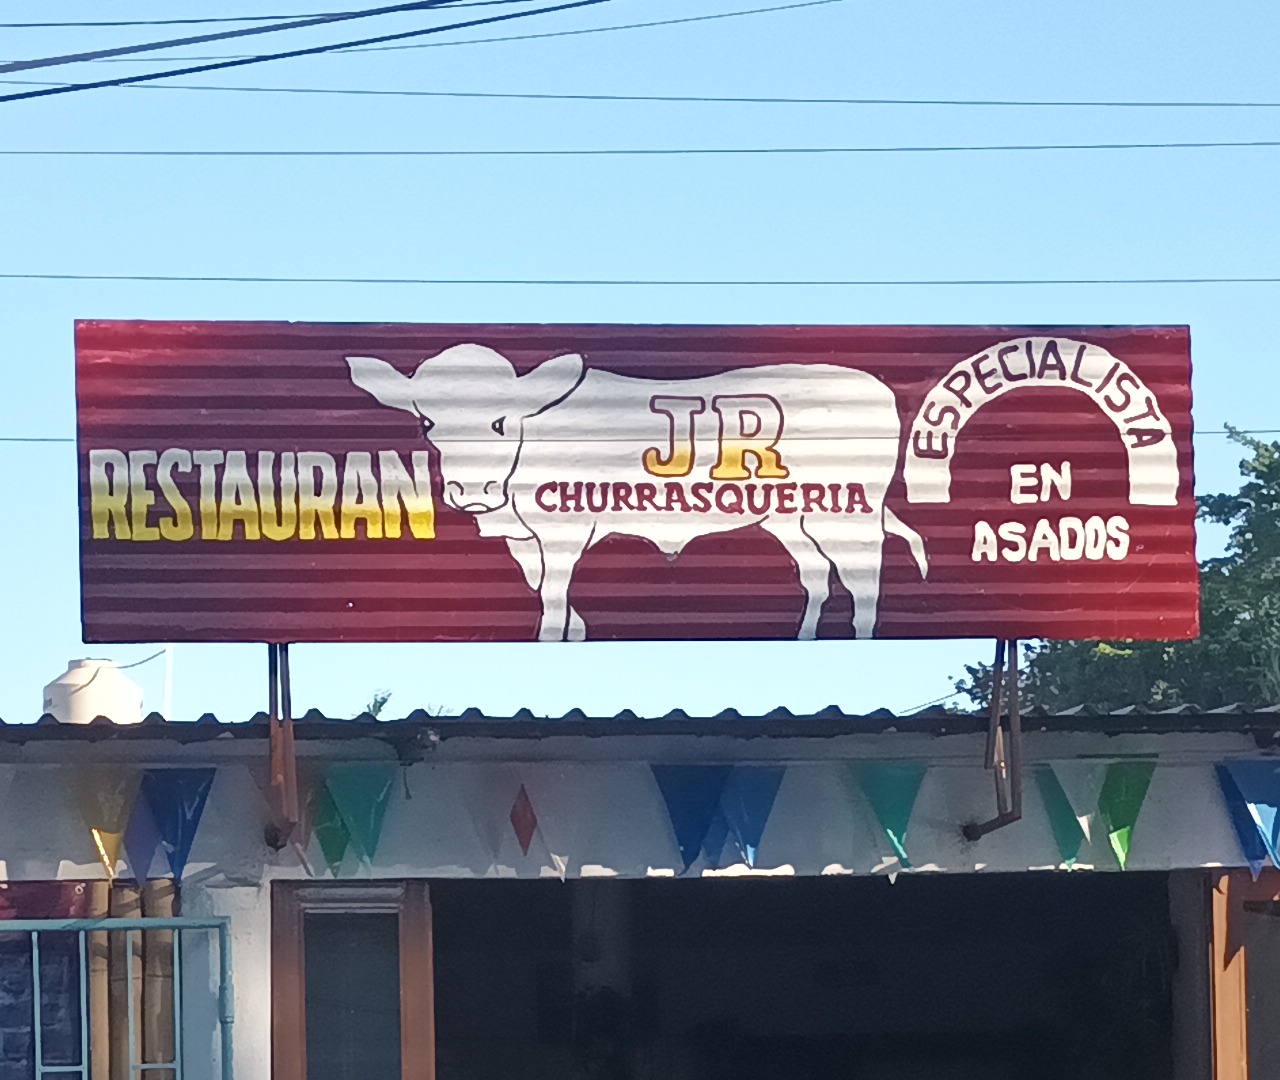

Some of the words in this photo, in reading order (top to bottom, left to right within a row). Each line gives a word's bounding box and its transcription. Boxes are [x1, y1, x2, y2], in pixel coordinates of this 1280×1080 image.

[912, 339, 1166, 460] ESPECIALISTA
[642, 394, 789, 480] JR
[88, 448, 436, 542] RESTAURAN
[534, 481, 873, 515] CHURRASQUERIA
[1010, 460, 1072, 505] EN
[971, 515, 1131, 563] ASADOS
